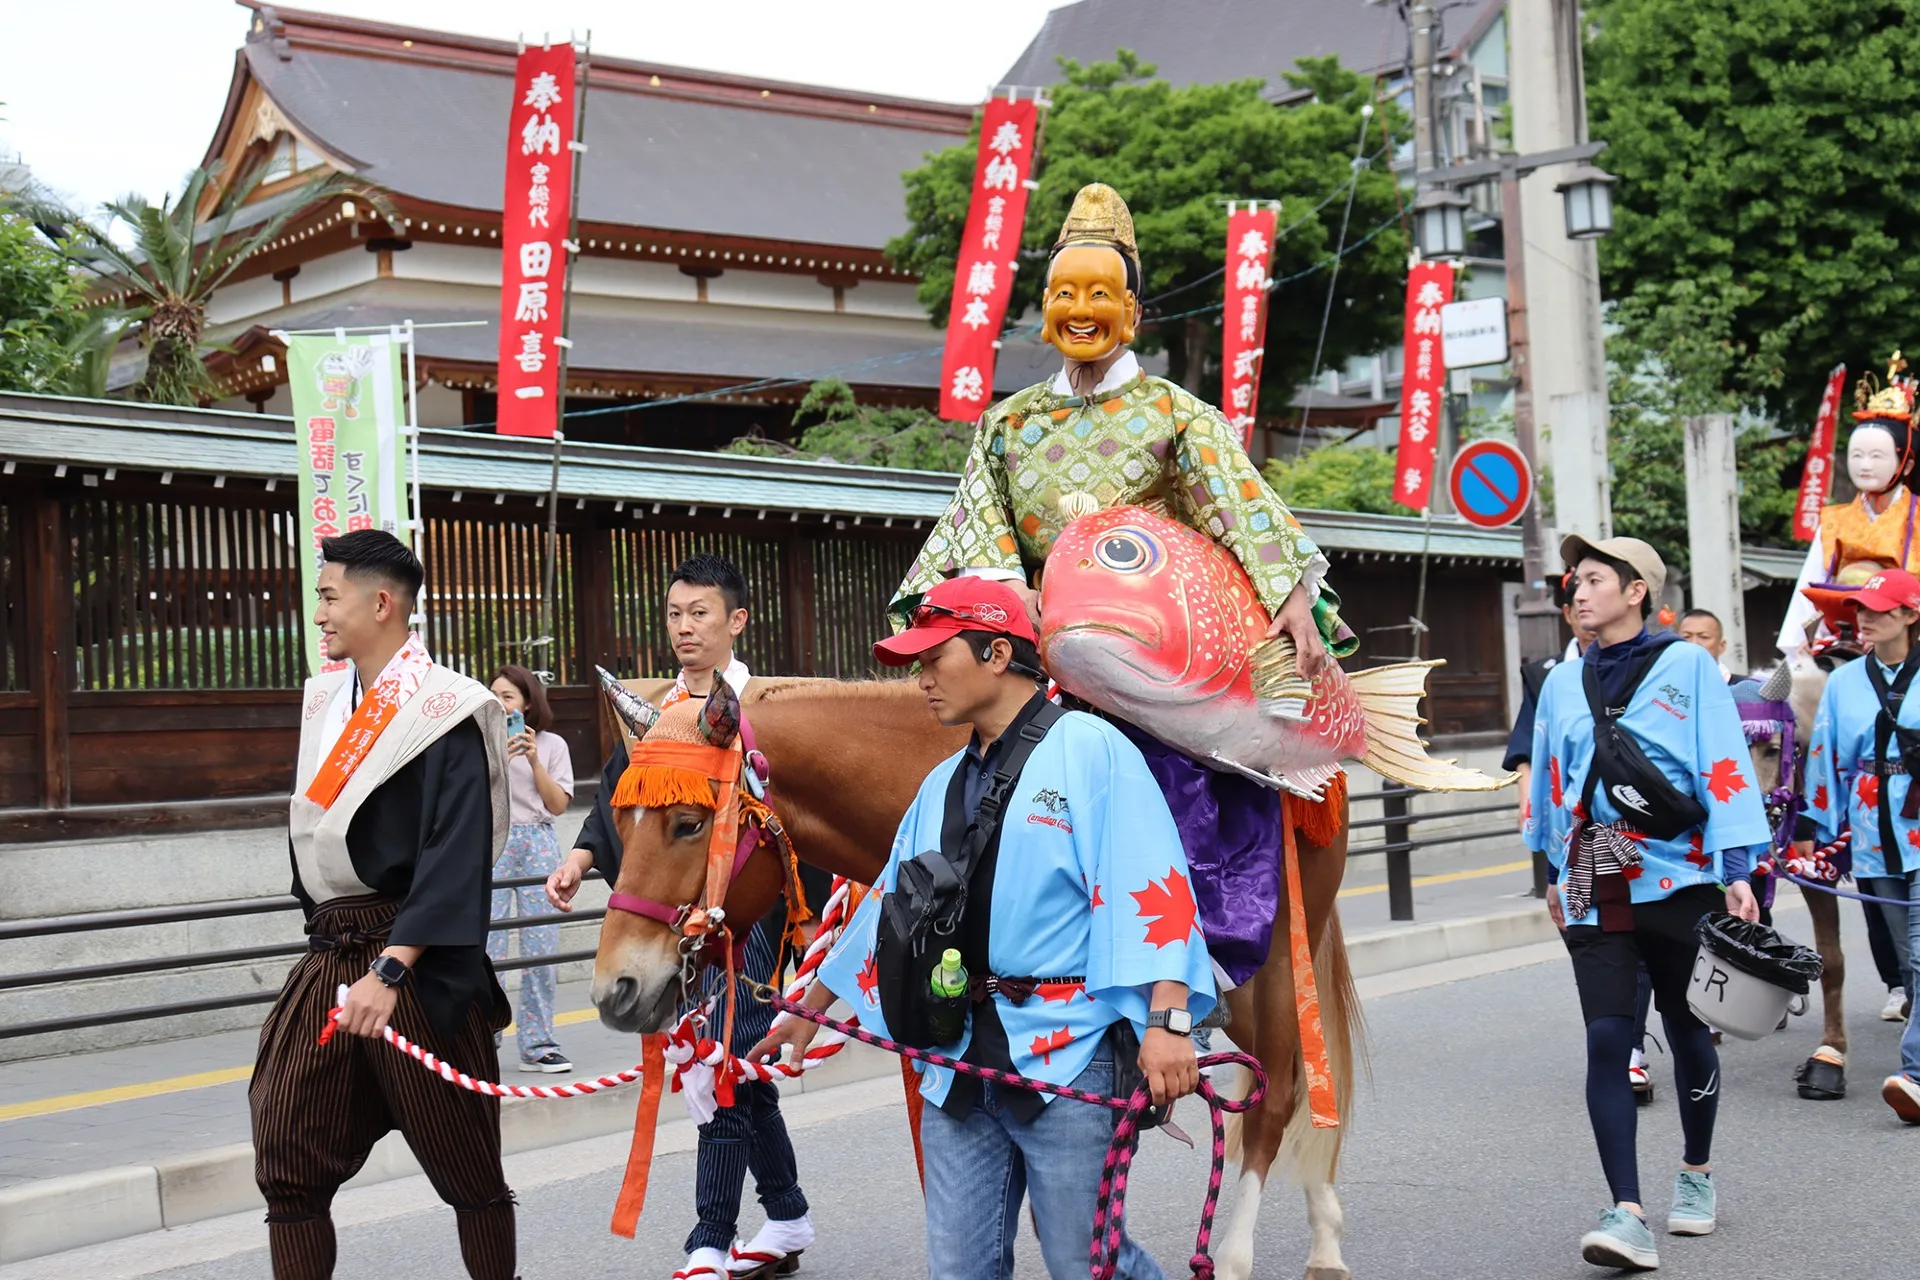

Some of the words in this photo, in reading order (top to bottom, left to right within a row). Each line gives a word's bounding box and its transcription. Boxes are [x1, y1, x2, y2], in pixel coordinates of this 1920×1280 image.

[522, 71, 562, 156] 奉納
[982, 120, 1023, 192] 奉納
[528, 161, 551, 229] 宮総代
[1236, 229, 1268, 291] 奉納
[514, 240, 552, 399] 田原喜一
[1413, 280, 1444, 336] 奉納
[1620, 785, 1650, 807] NIKE
[1694, 955, 1729, 1003] CR
